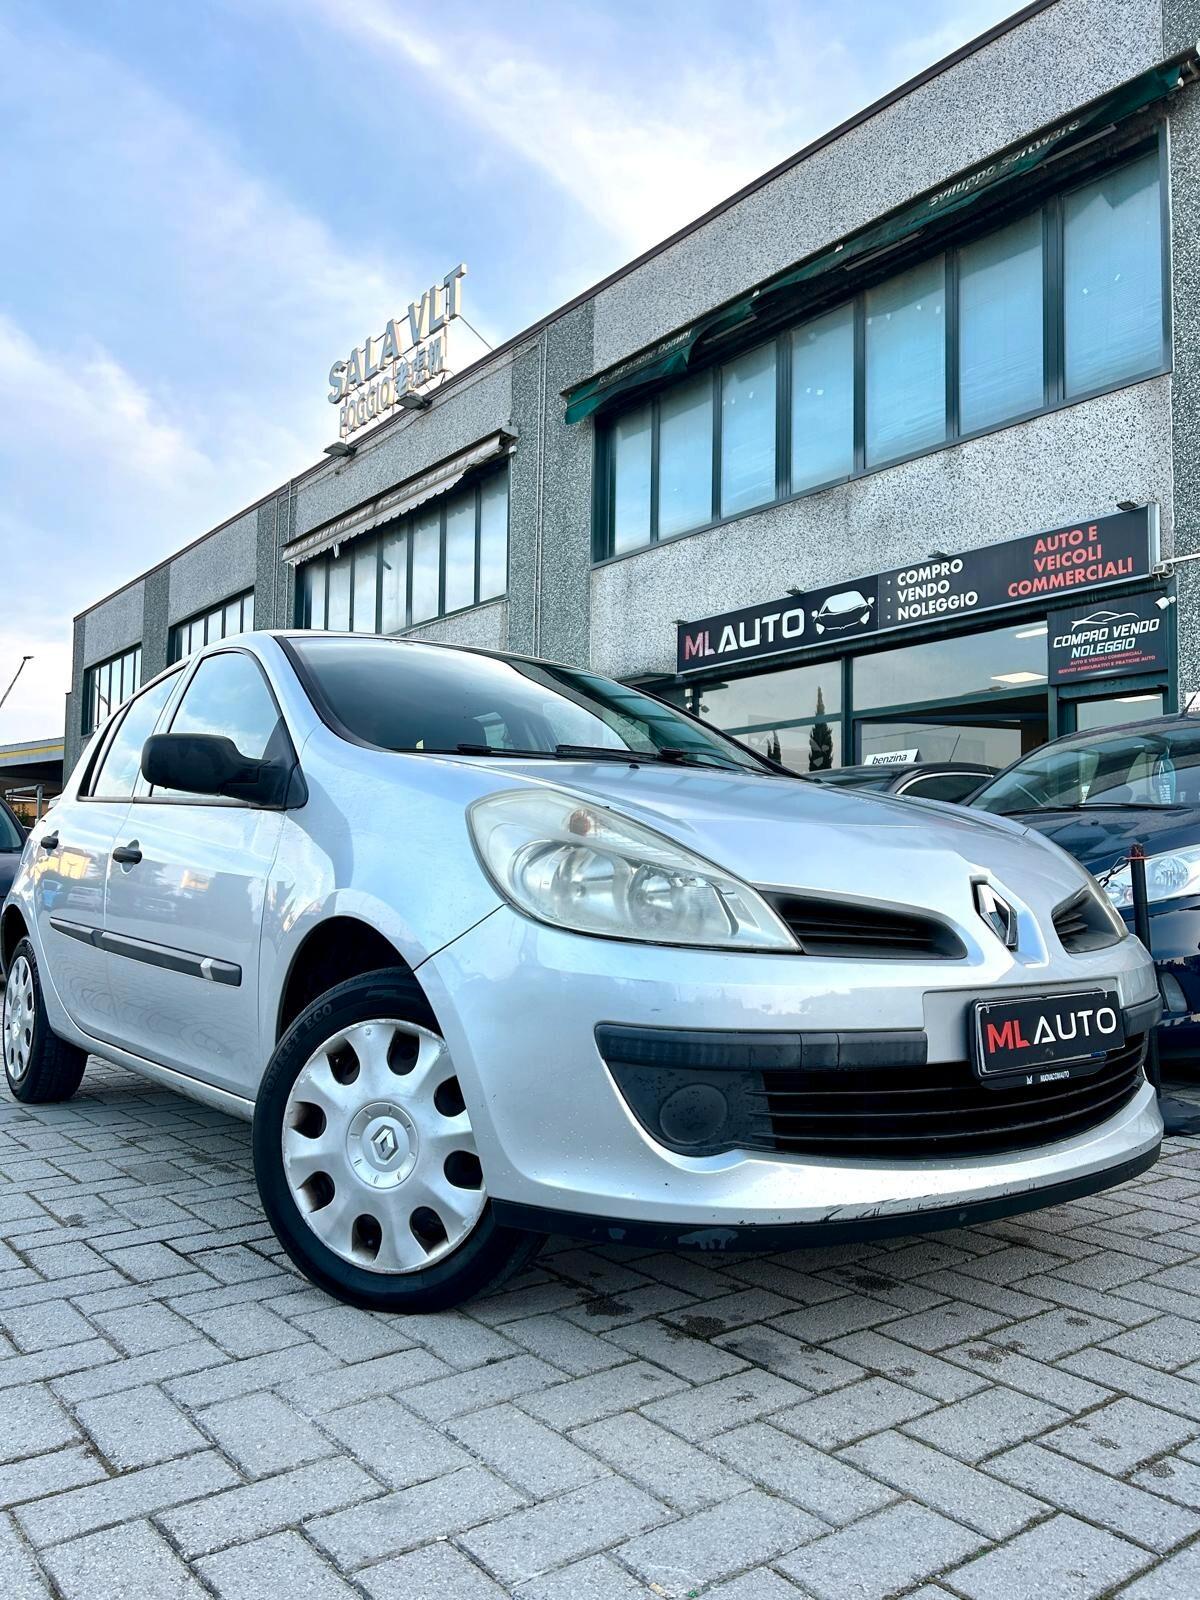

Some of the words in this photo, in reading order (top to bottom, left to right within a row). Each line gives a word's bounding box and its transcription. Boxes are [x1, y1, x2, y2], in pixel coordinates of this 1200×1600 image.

[328, 318, 403, 405] SALA
[408, 263, 468, 346] VLT
[339, 376, 396, 438] POGGIO
[1033, 530, 1084, 555] AUTO
[1088, 526, 1098, 542] E
[897, 559, 964, 586] COMPRO
[1033, 544, 1102, 573] VEICOLI
[897, 579, 951, 603] VENDO
[1007, 556, 1133, 597] COMMERCIALI
[897, 591, 979, 621] NOLEGGIO
[1053, 627, 1109, 649] COMPRO
[1113, 618, 1160, 638] VENDO
[1071, 637, 1136, 659] NOLEGGIO
[872, 754, 907, 765] benzina
[304, 1003, 333, 1029] ECO
